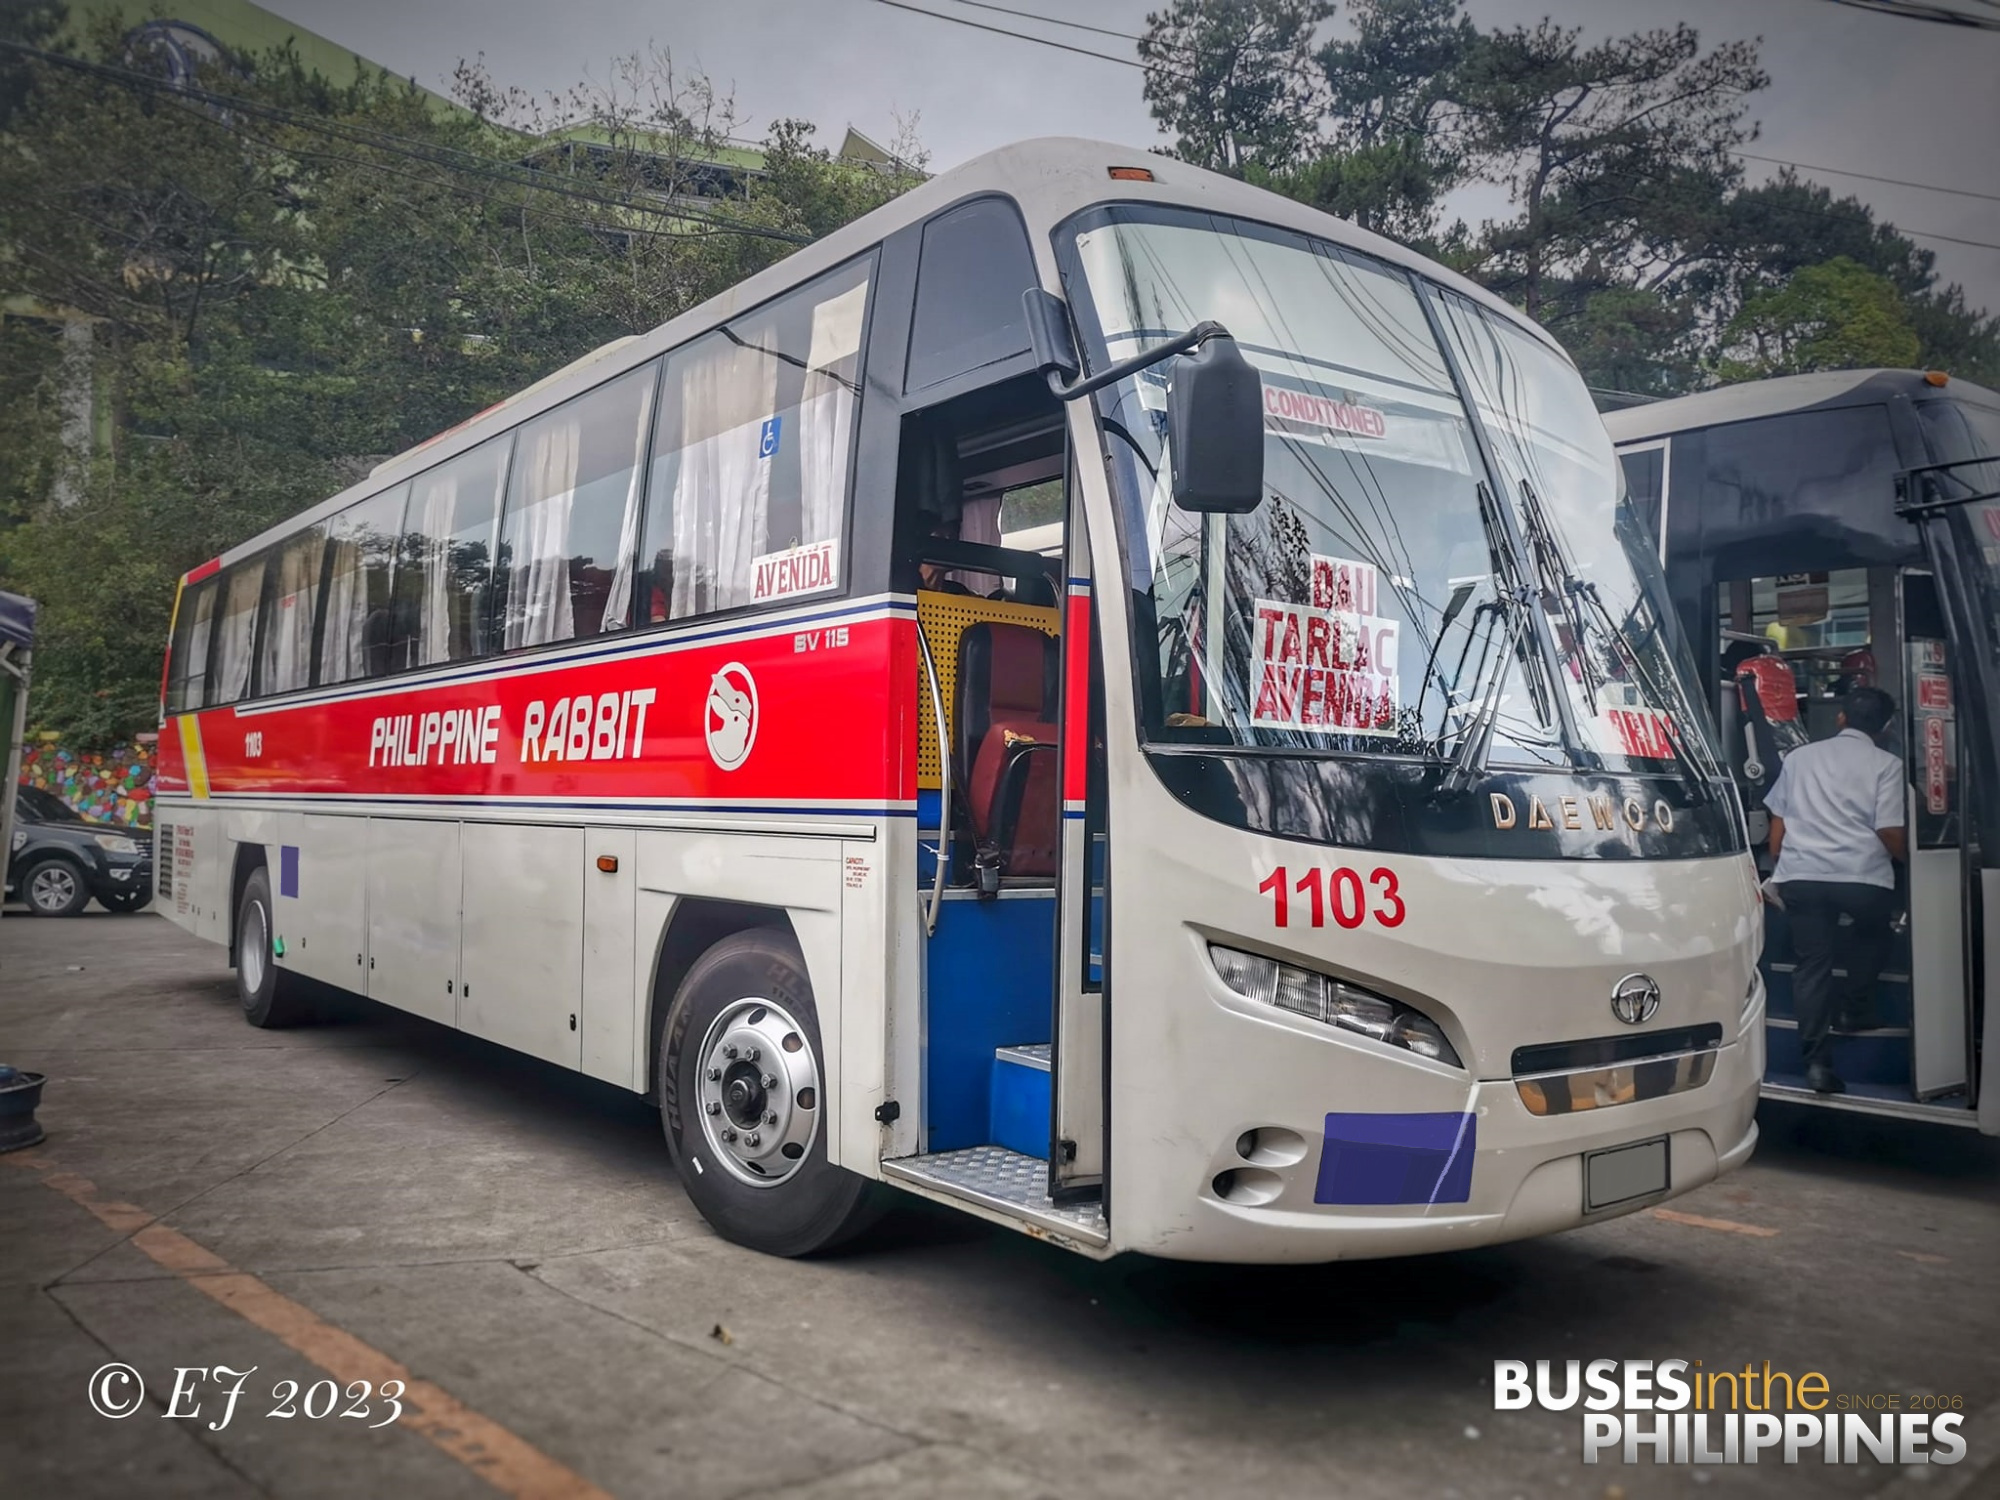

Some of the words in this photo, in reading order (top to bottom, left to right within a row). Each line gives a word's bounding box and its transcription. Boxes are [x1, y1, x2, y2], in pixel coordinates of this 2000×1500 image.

[1265, 388, 1385, 436] CONDITIONED
[754, 550, 832, 598] AVENIDA
[1313, 559, 1375, 616] DAU
[1259, 607, 1395, 677] TARLAC
[1254, 663, 1391, 729] AVENIDA
[369, 705, 502, 767] PHILIPPINE
[520, 687, 656, 763] RABBIT
[1490, 792, 1674, 833] DAEWOO
[1259, 866, 1406, 929] 1103
